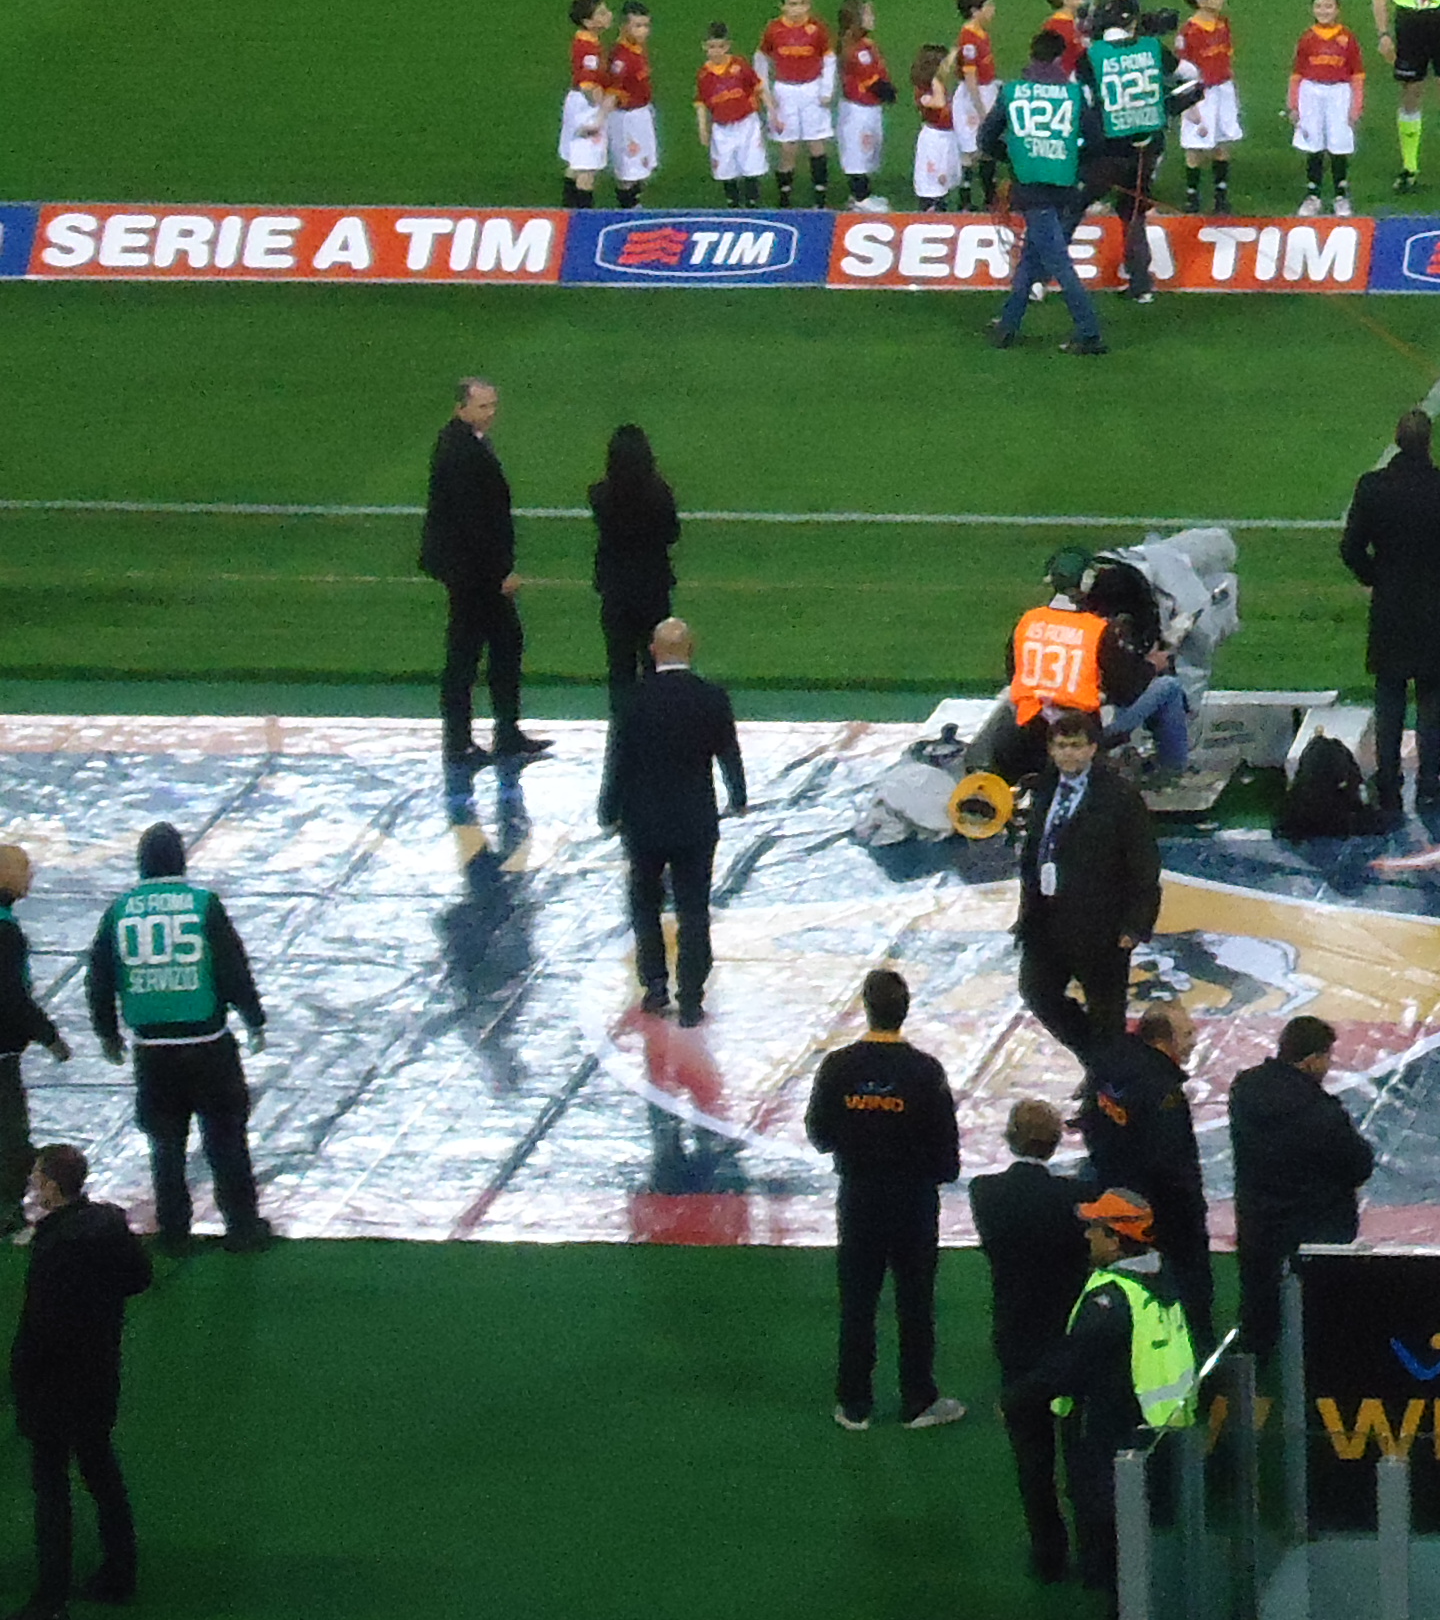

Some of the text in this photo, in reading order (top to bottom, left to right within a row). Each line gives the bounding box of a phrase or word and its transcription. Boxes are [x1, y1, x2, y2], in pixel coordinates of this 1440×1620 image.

[1014, 83, 1069, 100] AS ROMA
[1101, 69, 1160, 112] 025
[1008, 99, 1074, 139] 024
[41, 212, 555, 273] SERIE A TIM
[688, 231, 777, 266] TIM
[840, 223, 1104, 279] SERE
[1198, 225, 1359, 283] TIM
[1021, 641, 1084, 693] 031
[118, 914, 204, 966] 005
